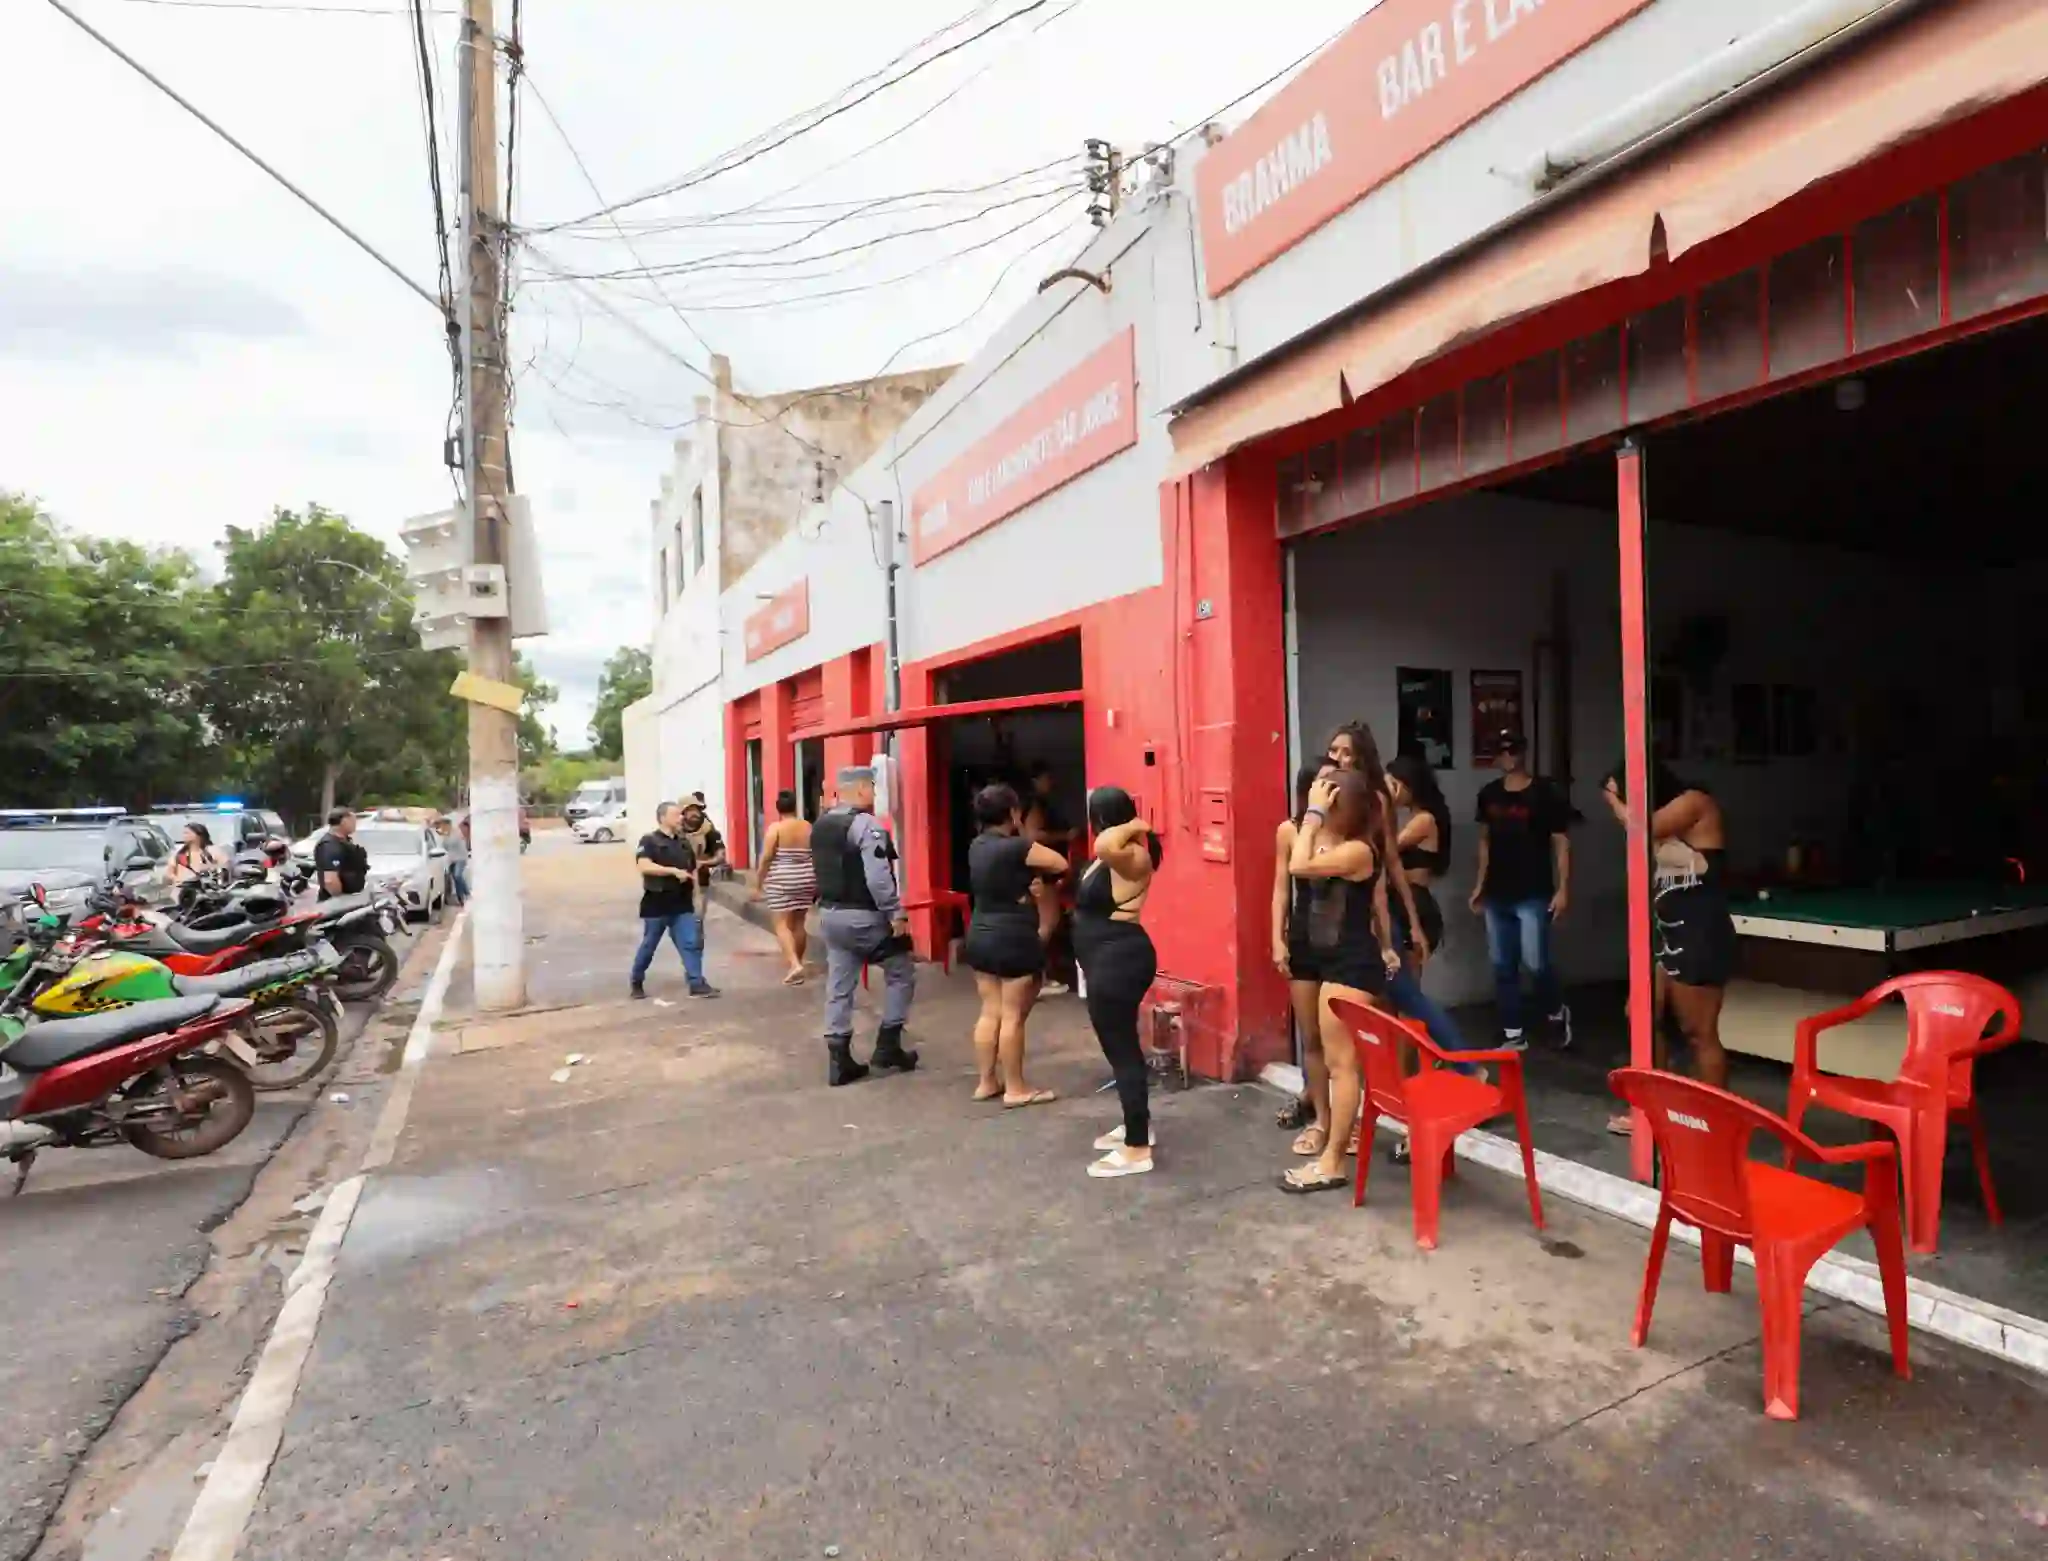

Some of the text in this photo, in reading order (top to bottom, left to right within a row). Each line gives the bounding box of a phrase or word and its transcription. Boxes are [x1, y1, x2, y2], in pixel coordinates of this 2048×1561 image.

[1222, 110, 1333, 234] BRAHMA
[1377, 20, 1447, 120] BAR
[1452, 0, 1478, 67] E
